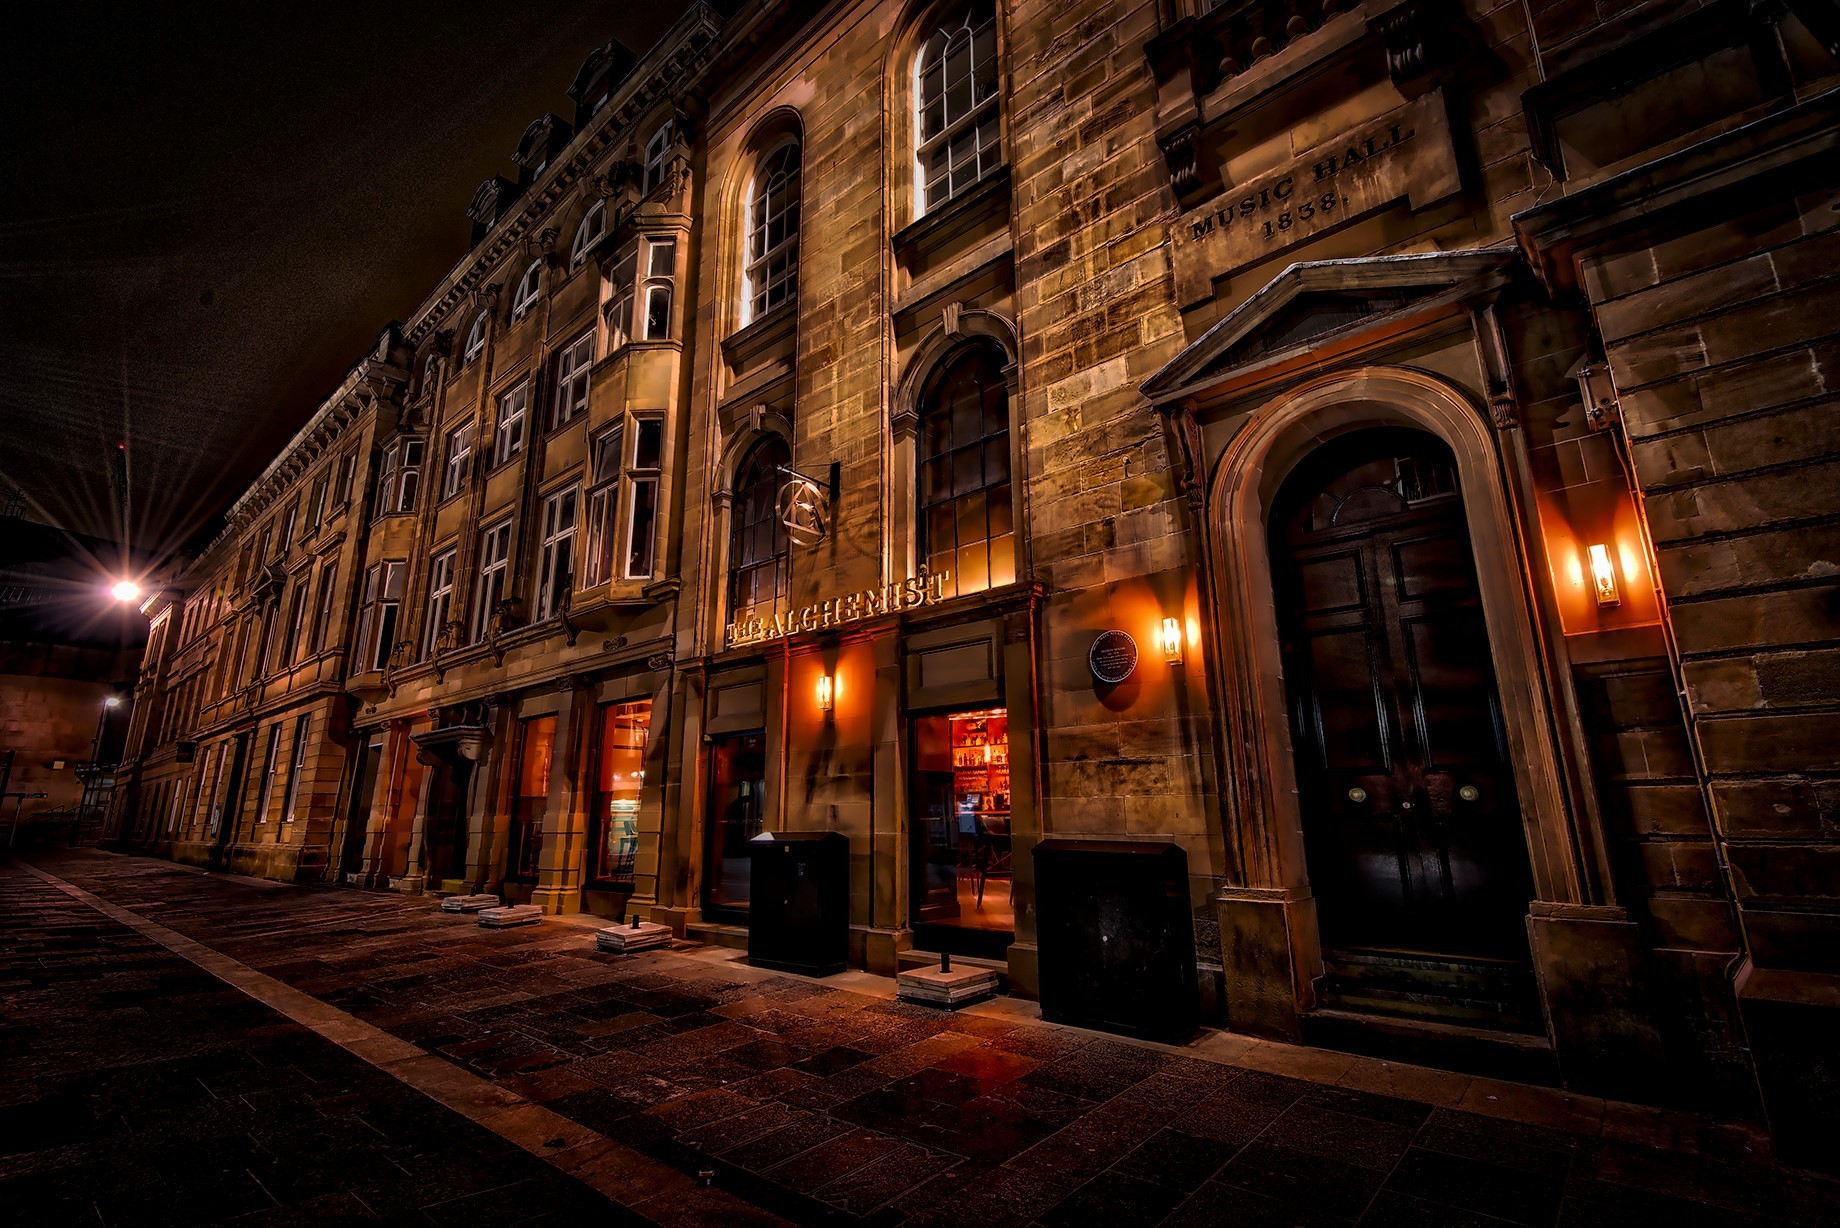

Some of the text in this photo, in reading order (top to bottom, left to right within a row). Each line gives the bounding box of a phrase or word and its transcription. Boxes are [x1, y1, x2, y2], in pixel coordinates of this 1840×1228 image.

[1190, 123, 1417, 241] MUSIC HALL
[726, 570, 950, 643] THE ALCHEMIST
